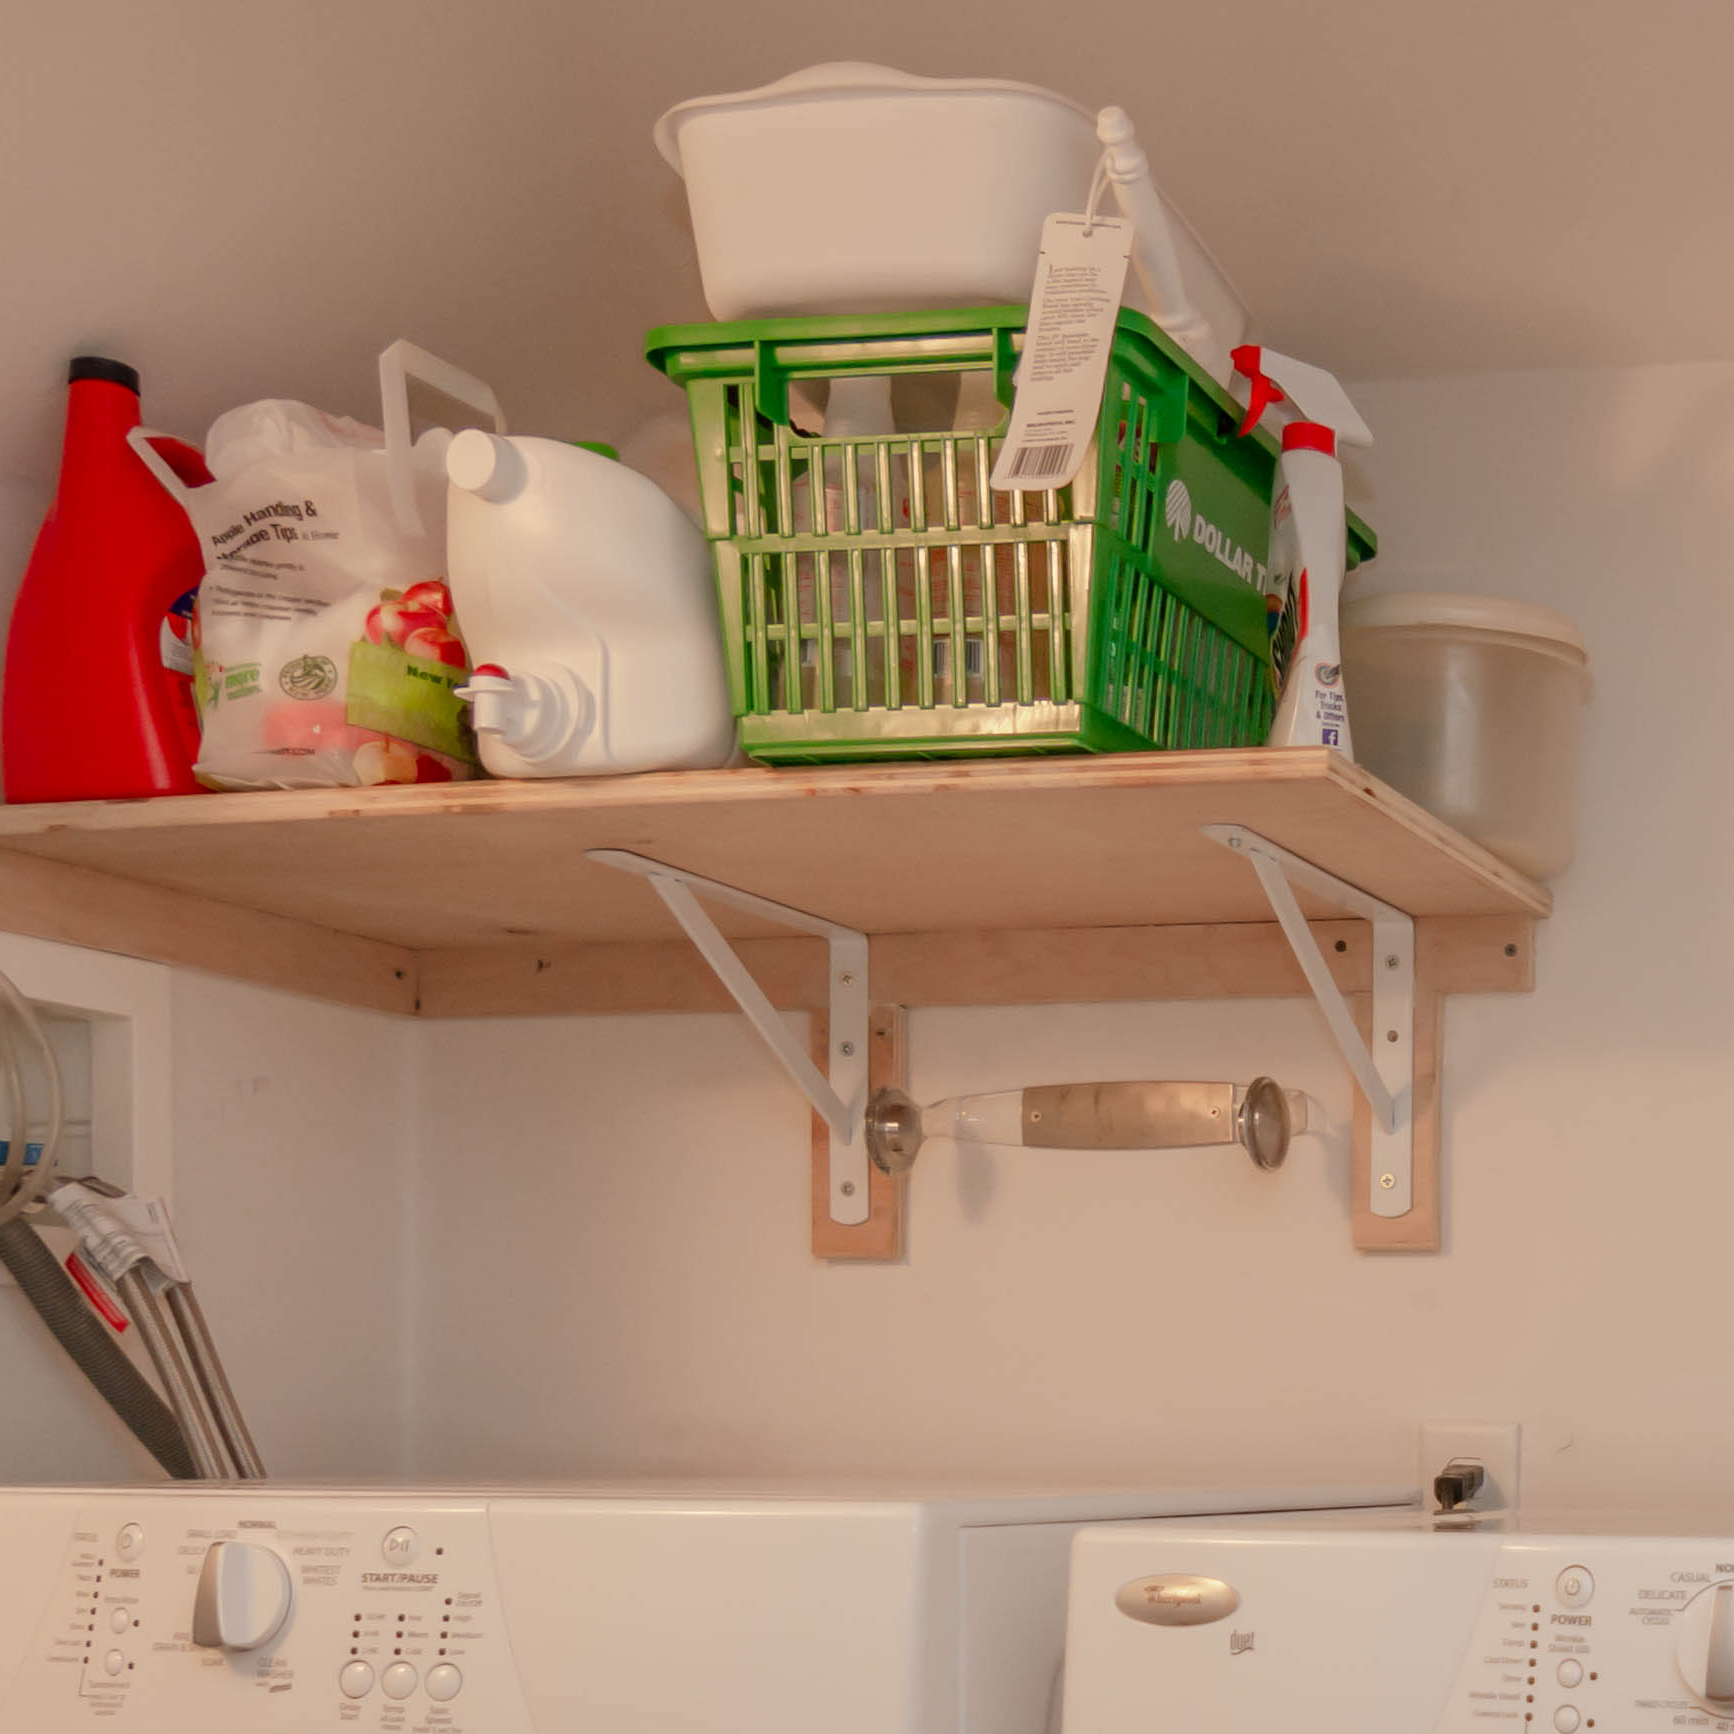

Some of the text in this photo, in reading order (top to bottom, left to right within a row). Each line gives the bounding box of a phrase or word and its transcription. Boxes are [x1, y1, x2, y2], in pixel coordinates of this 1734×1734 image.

[212, 523, 245, 547] Apple
[304, 500, 318, 517] &
[1193, 513, 1254, 585] DOLLAR
[407, 664, 444, 684] New
[1315, 690, 1327, 700] For
[1316, 710, 1322, 720] &
[238, 1520, 276, 1529] NORMAL
[293, 1547, 352, 1557] HEAVY DUTY
[361, 1573, 439, 1584] START/PAUSE
[1670, 1572, 1712, 1583] CASUAL
[1638, 1590, 1688, 1600] DELICATE
[1550, 1614, 1592, 1626] POWER
[1230, 1629, 1255, 1653] duet
[1687, 1717, 1709, 1726] min
[1715, 1722, 1729, 1732] 40
